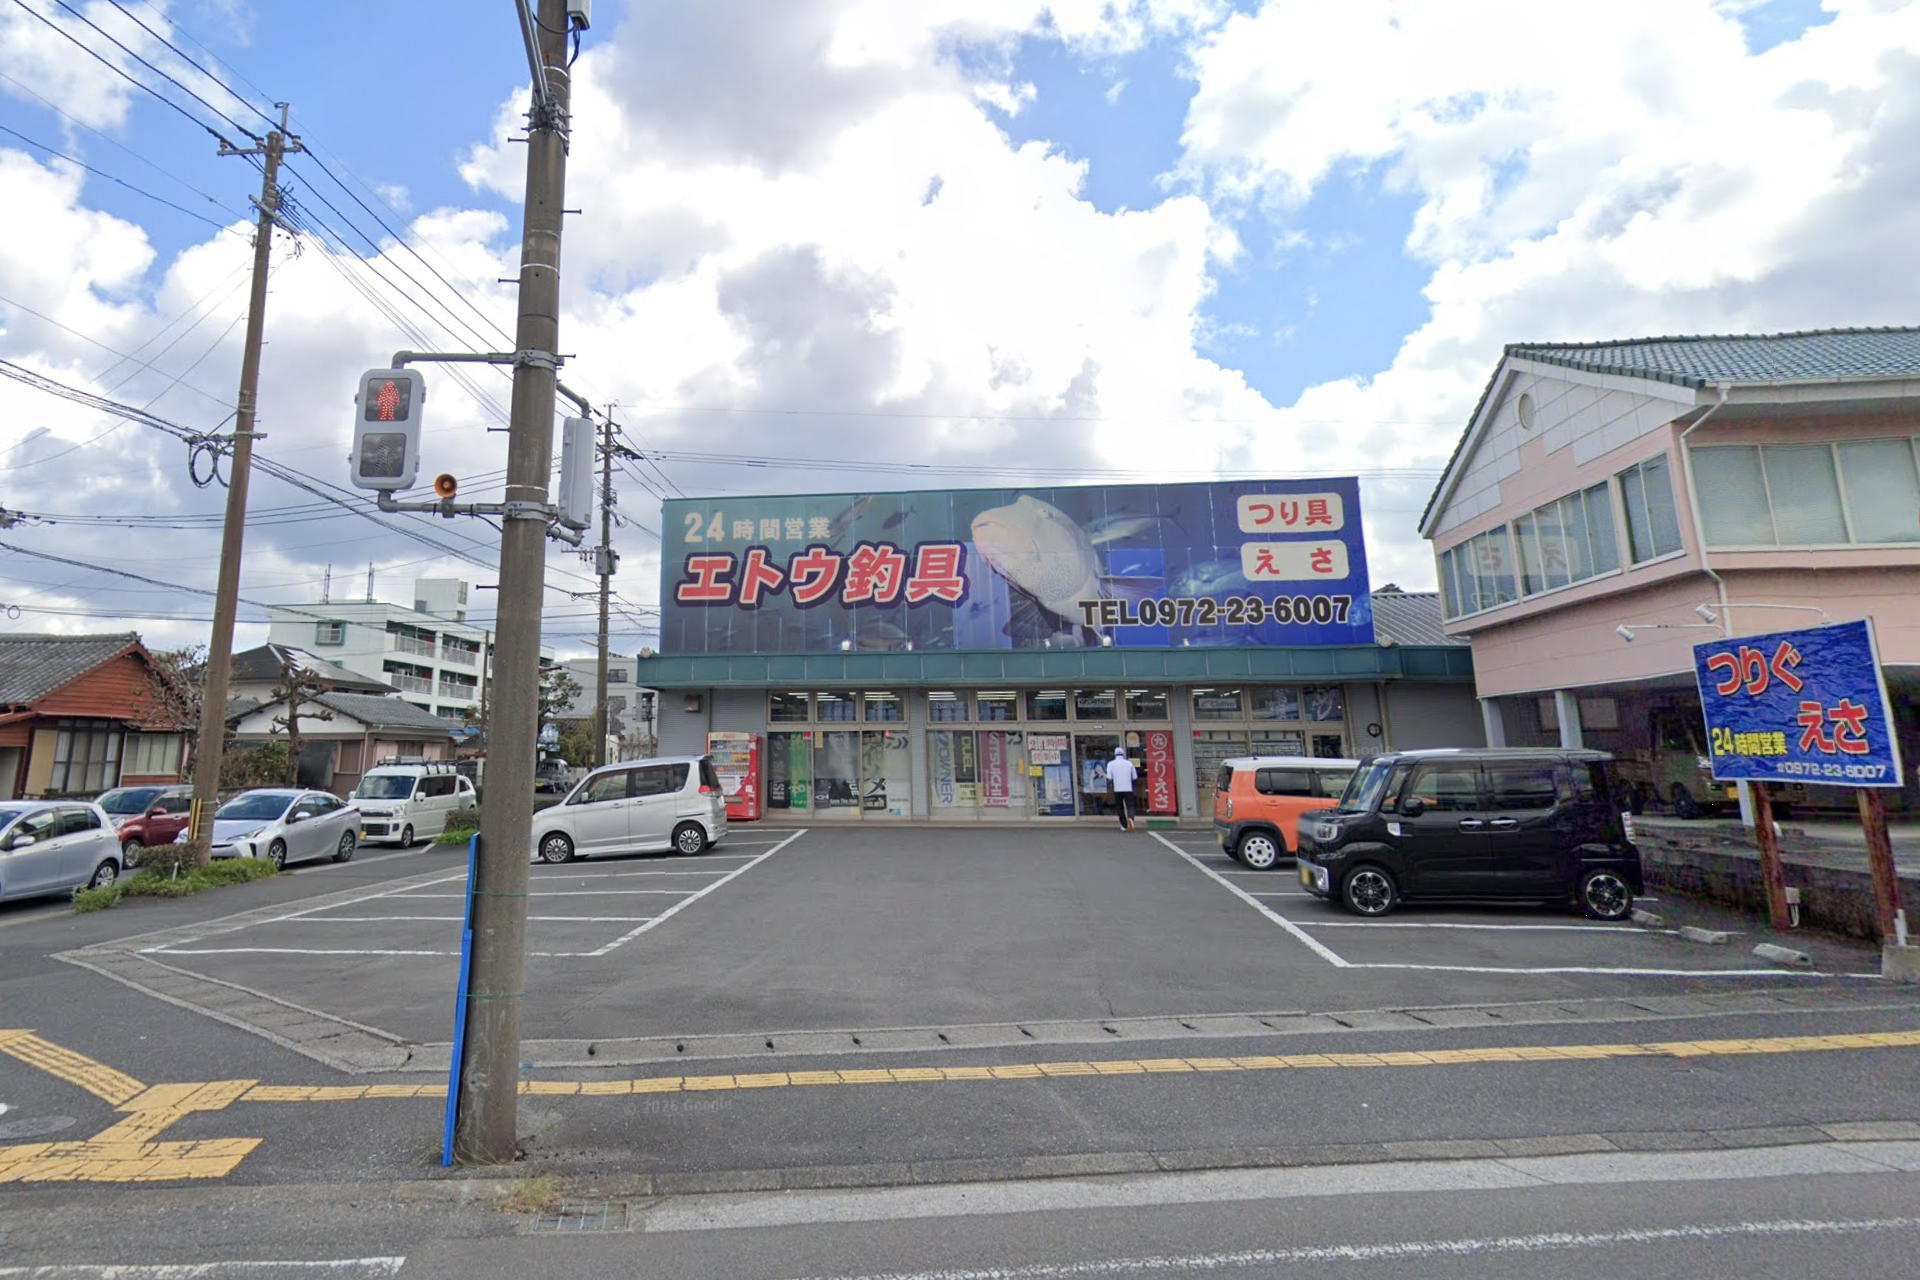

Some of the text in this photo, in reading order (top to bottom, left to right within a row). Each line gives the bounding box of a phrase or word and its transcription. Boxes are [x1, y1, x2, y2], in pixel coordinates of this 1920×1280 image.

[684, 511, 831, 543] 24時間営業
[1248, 499, 1333, 526] つり具
[676, 543, 965, 605] エトウ釣具
[1708, 640, 1803, 696] つりぐ
[1712, 727, 1788, 757] 24時間営業
[1797, 698, 1870, 754] えさ
[938, 746, 953, 804] OWNER
[961, 736, 973, 773] DUEL
